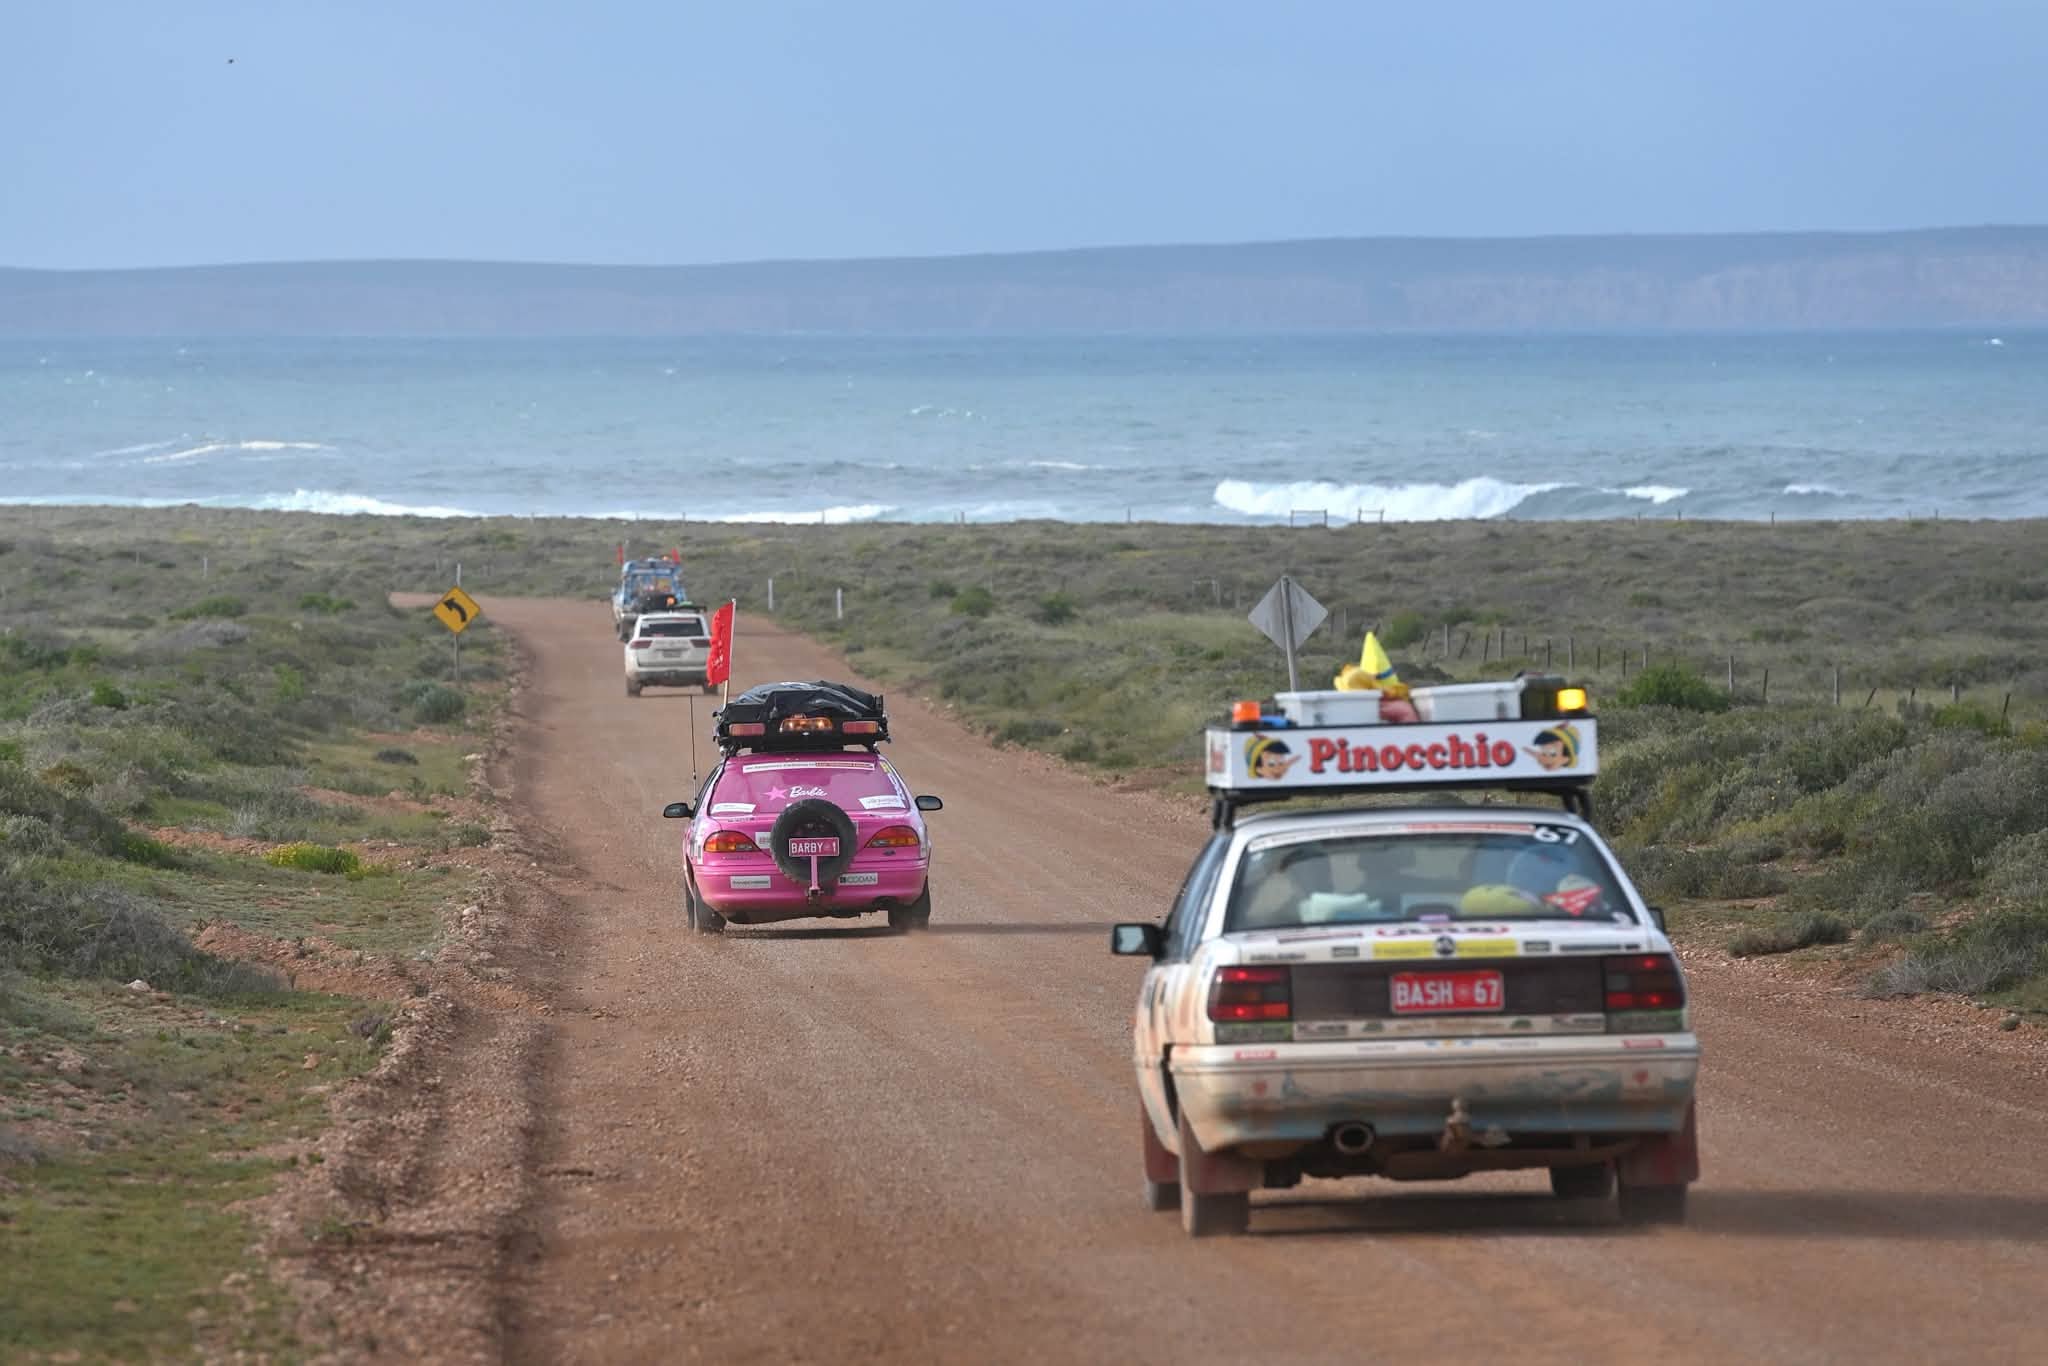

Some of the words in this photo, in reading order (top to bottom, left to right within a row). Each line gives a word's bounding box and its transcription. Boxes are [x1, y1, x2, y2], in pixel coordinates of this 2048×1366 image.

[1308, 733, 1517, 774] Pinocchio
[789, 785, 828, 798] Barbie
[1533, 826, 1580, 845] 67
[791, 842, 824, 854] BARBY
[1396, 980, 1455, 1006] BASH
[1473, 979, 1499, 1004] 67
